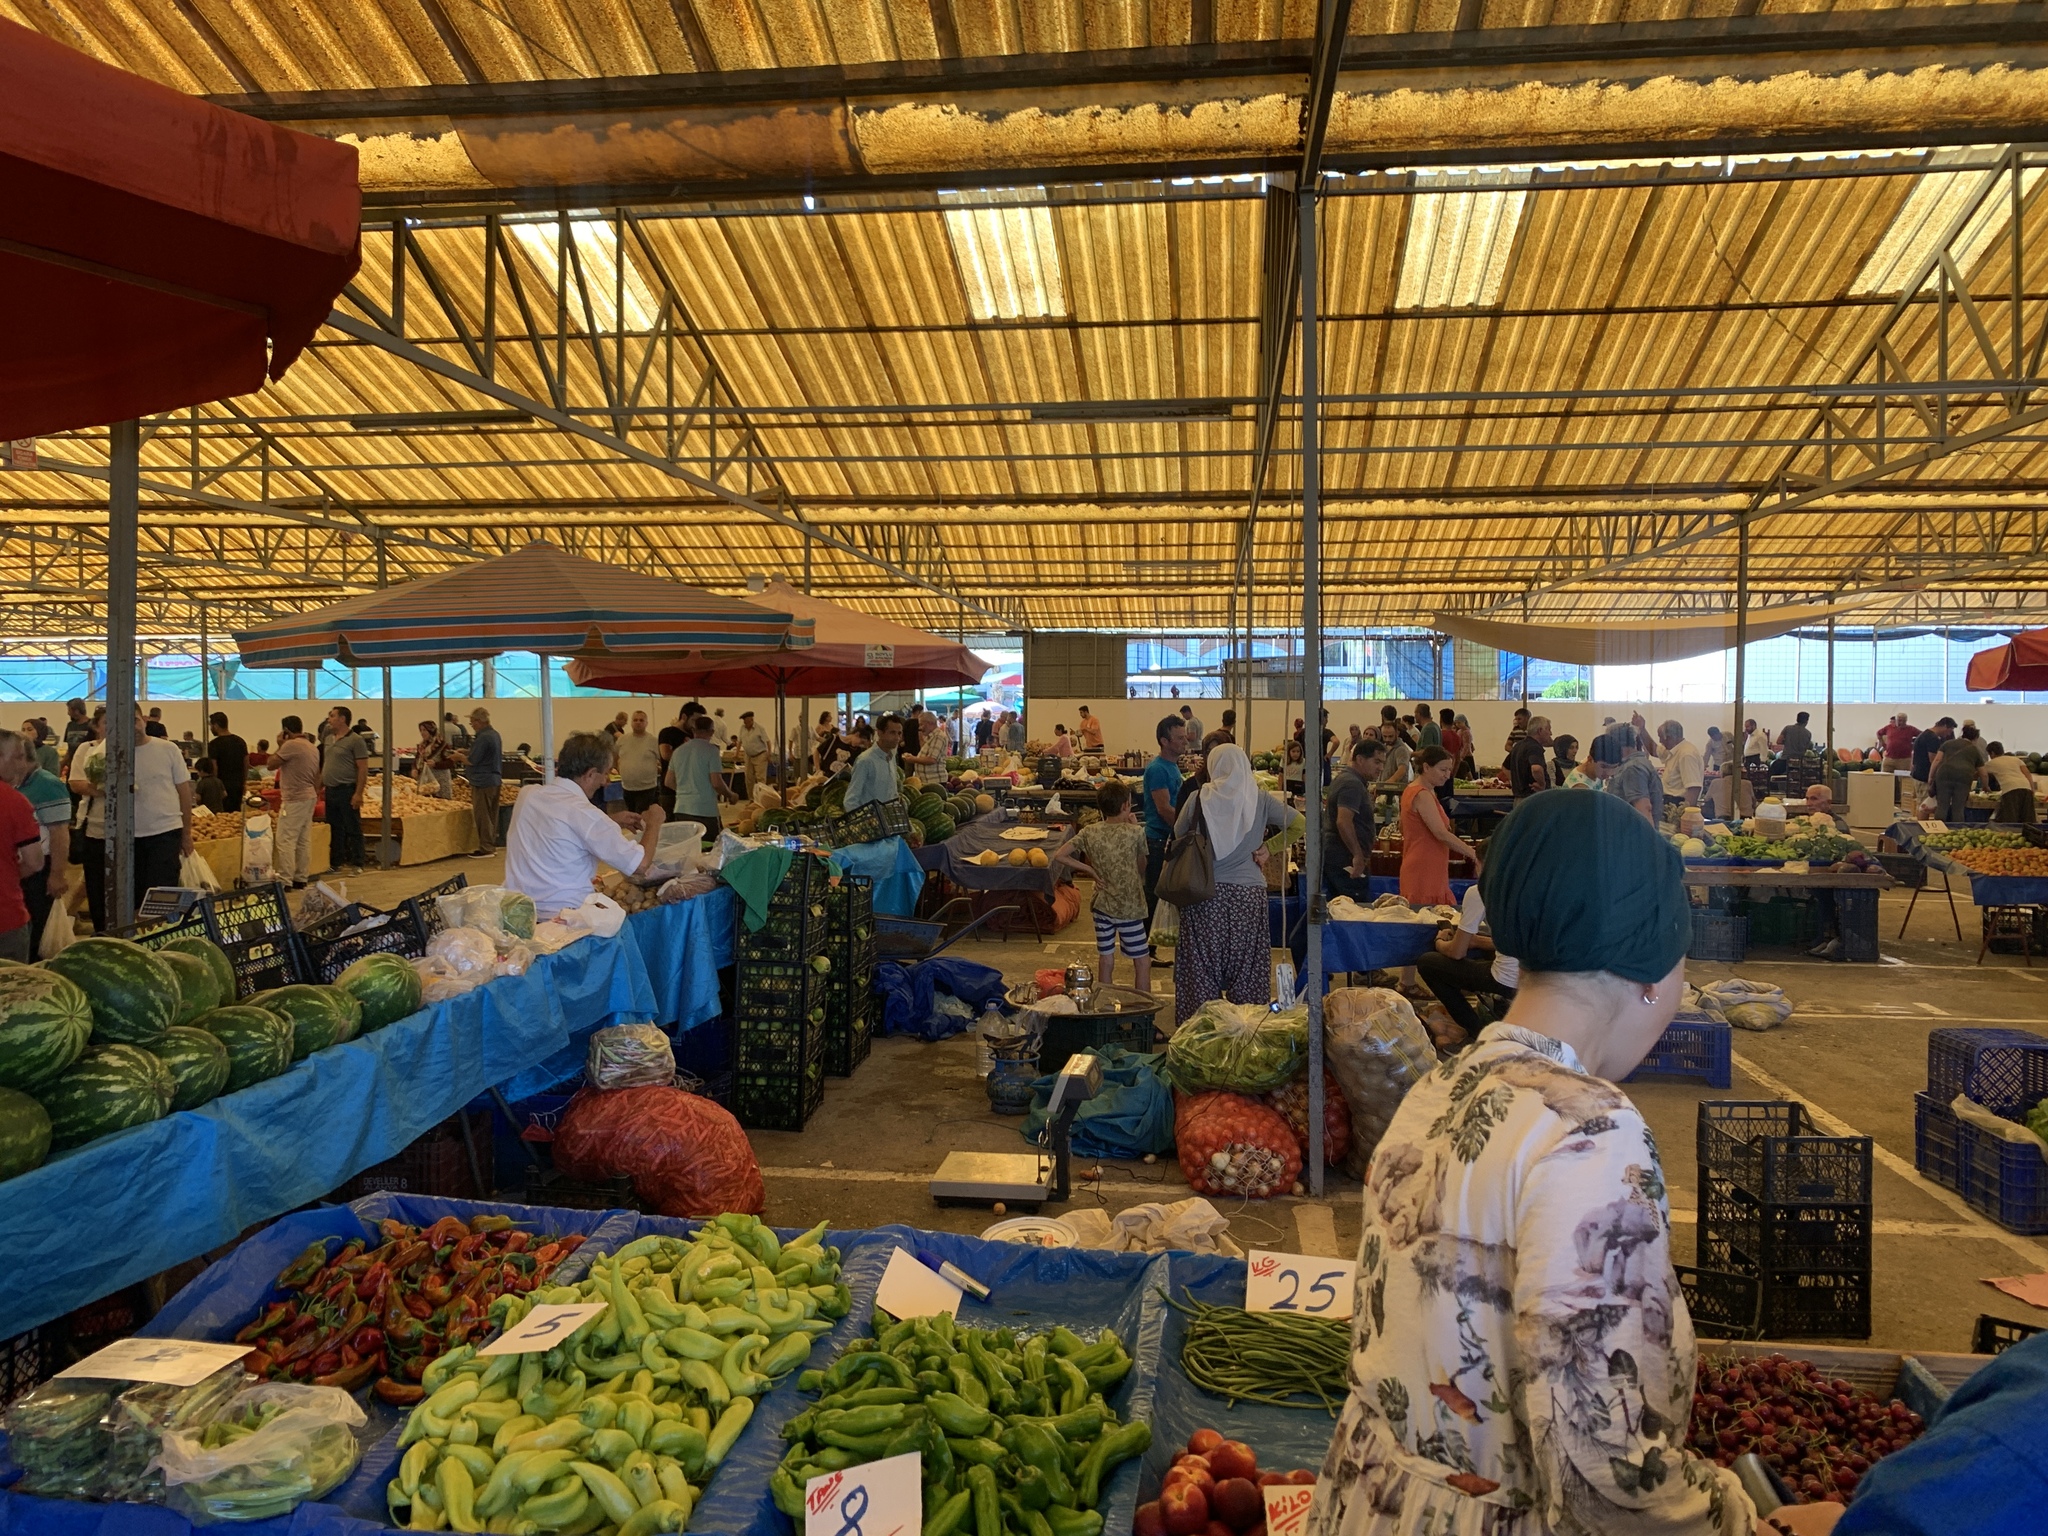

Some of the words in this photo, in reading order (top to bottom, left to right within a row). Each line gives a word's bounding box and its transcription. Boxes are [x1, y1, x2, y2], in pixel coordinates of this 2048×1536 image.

[401, 1178, 408, 1189] 8
[1252, 1256, 1275, 1273] KG
[1269, 1269, 1346, 1313] 25
[518, 1311, 584, 1339] 5
